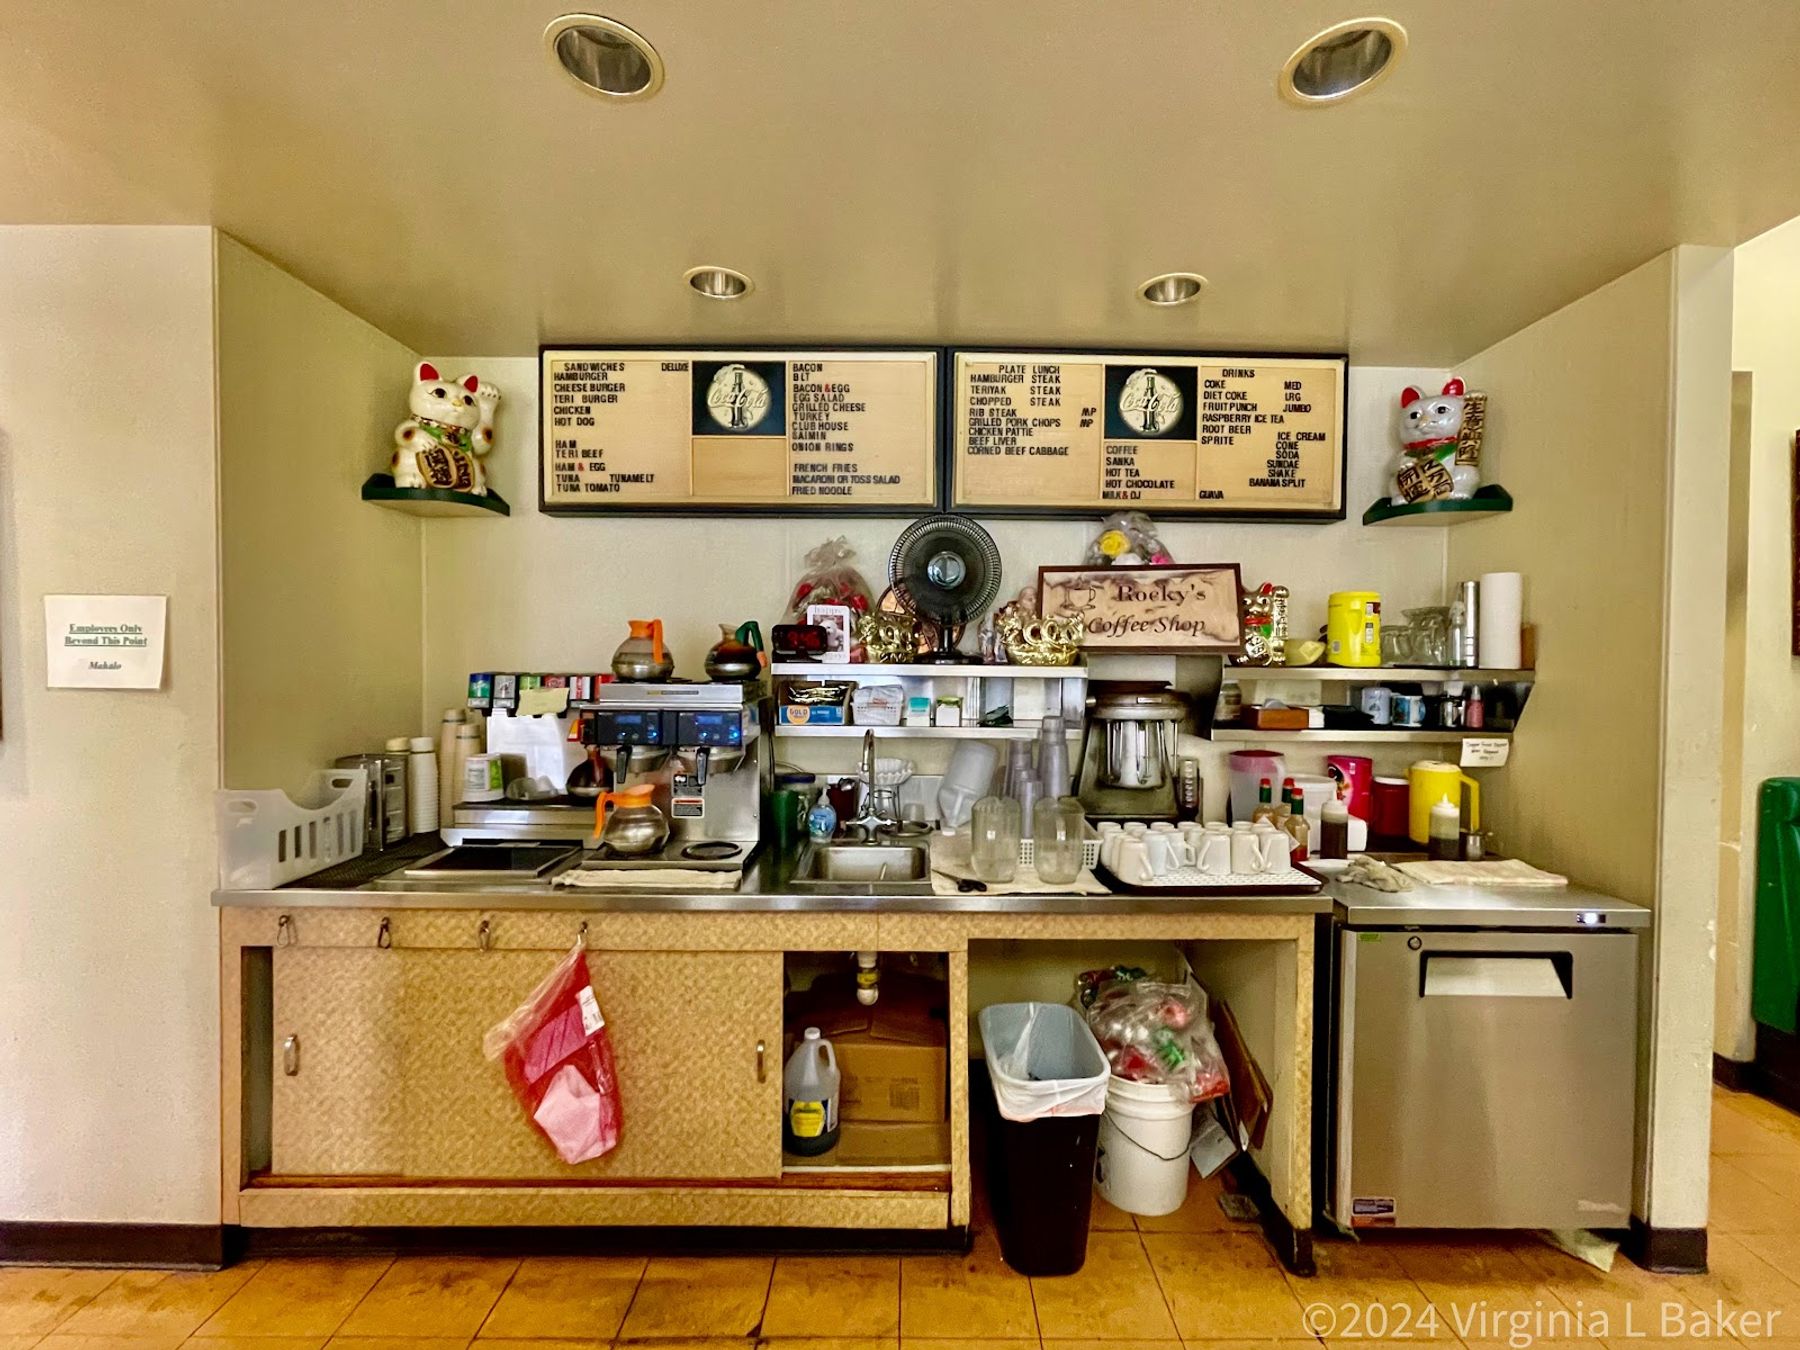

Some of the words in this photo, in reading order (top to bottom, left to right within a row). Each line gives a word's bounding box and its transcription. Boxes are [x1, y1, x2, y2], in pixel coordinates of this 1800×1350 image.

[564, 363, 625, 372] SANDWICHES
[793, 364, 823, 372] BACON
[999, 365, 1026, 374] PLATE
[1033, 365, 1060, 374] LUNCH
[554, 372, 608, 381] HAMBURGER
[793, 373, 810, 381] BLT
[1222, 369, 1255, 378] DRINKS
[970, 374, 1024, 383] HAMBURGER
[1031, 374, 1061, 384] STEAK
[554, 384, 587, 392] CHEESE
[590, 383, 625, 392] BURGER
[793, 384, 822, 392] BACON
[1204, 380, 1226, 388] COKE
[1284, 381, 1302, 390] MED
[970, 385, 1006, 394] TERIYAK
[1030, 386, 1061, 395] STEAK
[554, 395, 574, 403] TERI
[582, 394, 618, 403] BURGER
[793, 394, 812, 402] EGG
[814, 394, 844, 402] SALAD
[1203, 391, 1223, 400] DIET
[1226, 391, 1247, 400] COKE
[1285, 392, 1301, 401] LRG
[970, 397, 1012, 406] CHOPPED
[1030, 397, 1061, 407] STEAK
[1203, 402, 1228, 411] FRUIT
[1229, 403, 1257, 411] PUNCH
[554, 406, 591, 415] CHICKEN
[792, 403, 829, 412] GRILLED
[832, 403, 865, 412] CHEESE
[970, 408, 987, 417] RIB
[989, 408, 1017, 417] STEAK
[1082, 407, 1097, 416] MP
[1283, 404, 1311, 413] JUMBO
[794, 412, 830, 421] TURKEY
[1202, 413, 1250, 423] RASPBERRY
[1254, 414, 1268, 423] ICE
[1270, 414, 1284, 424] TEA
[555, 418, 571, 426] HOT
[577, 418, 595, 426] DOG
[792, 422, 817, 430] CLUB
[818, 422, 848, 430] HOUSE
[969, 418, 1001, 426] GRILLED
[1006, 418, 1028, 427] PORK
[1032, 418, 1061, 427] CHOPS
[1080, 418, 1093, 428] MP
[969, 427, 1003, 436] CHICKEN
[1005, 427, 1033, 436] PATTIE
[1202, 424, 1224, 433] ROOT
[1228, 425, 1251, 434] BEER
[792, 432, 826, 440] SAIMIN
[969, 436, 989, 445] BEEF
[993, 436, 1017, 445] LIVER
[1202, 436, 1234, 445] SPRITE
[1278, 431, 1292, 440] ICE
[1296, 432, 1325, 441] CREAM
[556, 440, 576, 448] HAM
[792, 442, 821, 451] ONION
[825, 442, 854, 451] RINGS
[1276, 441, 1299, 450] CONE
[556, 450, 578, 458] TERI
[582, 450, 604, 458] BEEF
[967, 446, 1001, 455] CORNED
[1005, 447, 1026, 455] BEEF
[1029, 446, 1069, 455] CABBAGE
[1106, 446, 1138, 454] COFFEE
[1276, 450, 1299, 459] SODA
[1106, 457, 1135, 466] SANKA
[1267, 459, 1299, 469] SUNDAE
[555, 463, 575, 471] HAM
[578, 463, 584, 471] &
[590, 463, 605, 471] EGG
[794, 464, 828, 472] FRENCH
[832, 464, 858, 472] FRIES
[1106, 468, 1121, 477] HOT
[1125, 469, 1140, 477] TEA
[1268, 469, 1296, 478] SHAKE
[556, 474, 580, 482] TUNA
[793, 475, 835, 483] MACARONI
[838, 475, 848, 483] OR
[850, 475, 871, 483] TOSS
[873, 476, 900, 484] SALAD
[1105, 480, 1121, 488] HOT
[1126, 480, 1175, 489] CHOCOLATE
[1249, 478, 1281, 487] BANANA
[1282, 478, 1305, 488] SPLIT
[557, 484, 580, 492] TUNA
[585, 484, 620, 492] TOMATO
[792, 487, 816, 495] FRIED
[819, 487, 852, 495] NOODLE
[1199, 491, 1224, 500] GUAVA
[120, 624, 142, 634] Only
[1088, 615, 1148, 637] Coffee
[1154, 615, 1206, 636] Shop
[64, 636, 98, 646] Beyond
[101, 636, 120, 646] This
[123, 637, 147, 647] Point
[89, 661, 121, 670] Mahalo
